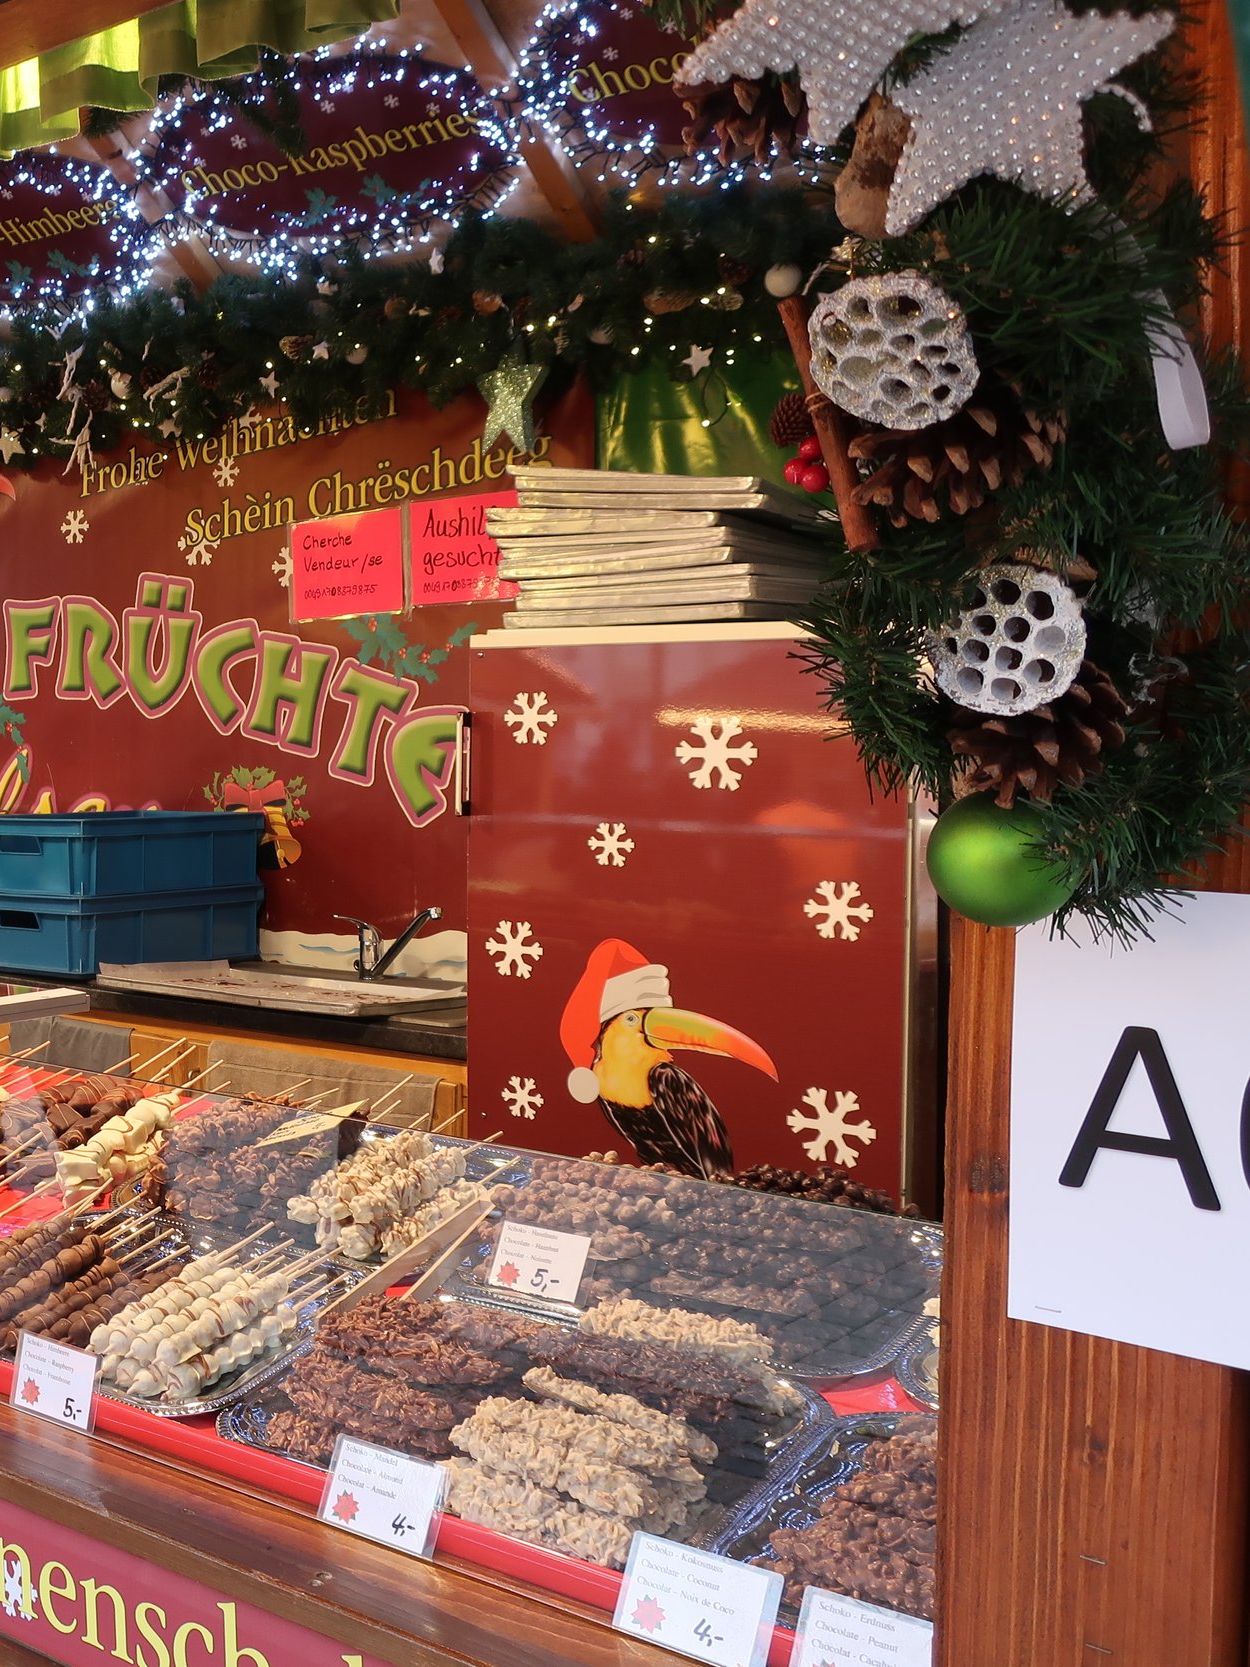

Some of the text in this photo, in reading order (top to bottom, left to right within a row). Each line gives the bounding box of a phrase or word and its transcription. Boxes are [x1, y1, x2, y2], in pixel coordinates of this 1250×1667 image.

[79, 445, 164, 498] Frohe
[186, 490, 297, 546] Schèin
[422, 504, 498, 540] Aushil
[302, 532, 353, 551] Cherche
[303, 554, 359, 573] Vendeur
[423, 543, 502, 576] gesucht
[3, 573, 469, 826] FRÜCHTE
[1058, 1025, 1250, 1212] A
[530, 1268, 560, 1293] 5,-
[62, 1397, 83, 1421] 5,-
[345, 1444, 368, 1457] Schoko
[374, 1453, 399, 1467] Mandel
[337, 1474, 366, 1489] Chocolat
[341, 1459, 372, 1475] Chocolate
[378, 1471, 404, 1485] Almond
[391, 1513, 416, 1537] 4,-
[644, 1541, 675, 1558] Schoko
[680, 1552, 725, 1574] Kokosnuss
[640, 1558, 680, 1578] Chocolate
[686, 1574, 721, 1592] Coconut
[636, 1576, 671, 1594] Chocolat
[680, 1590, 700, 1605] Noix
[701, 1597, 712, 1608] de
[712, 1602, 735, 1616] Coco
[693, 1618, 725, 1648] 4,-
[818, 1601, 852, 1619] Schoko
[860, 1614, 896, 1633] Erdnuss
[811, 1638, 851, 1658] Chocolat
[814, 1620, 860, 1641] Chocolate
[867, 1635, 899, 1654] Peanut
